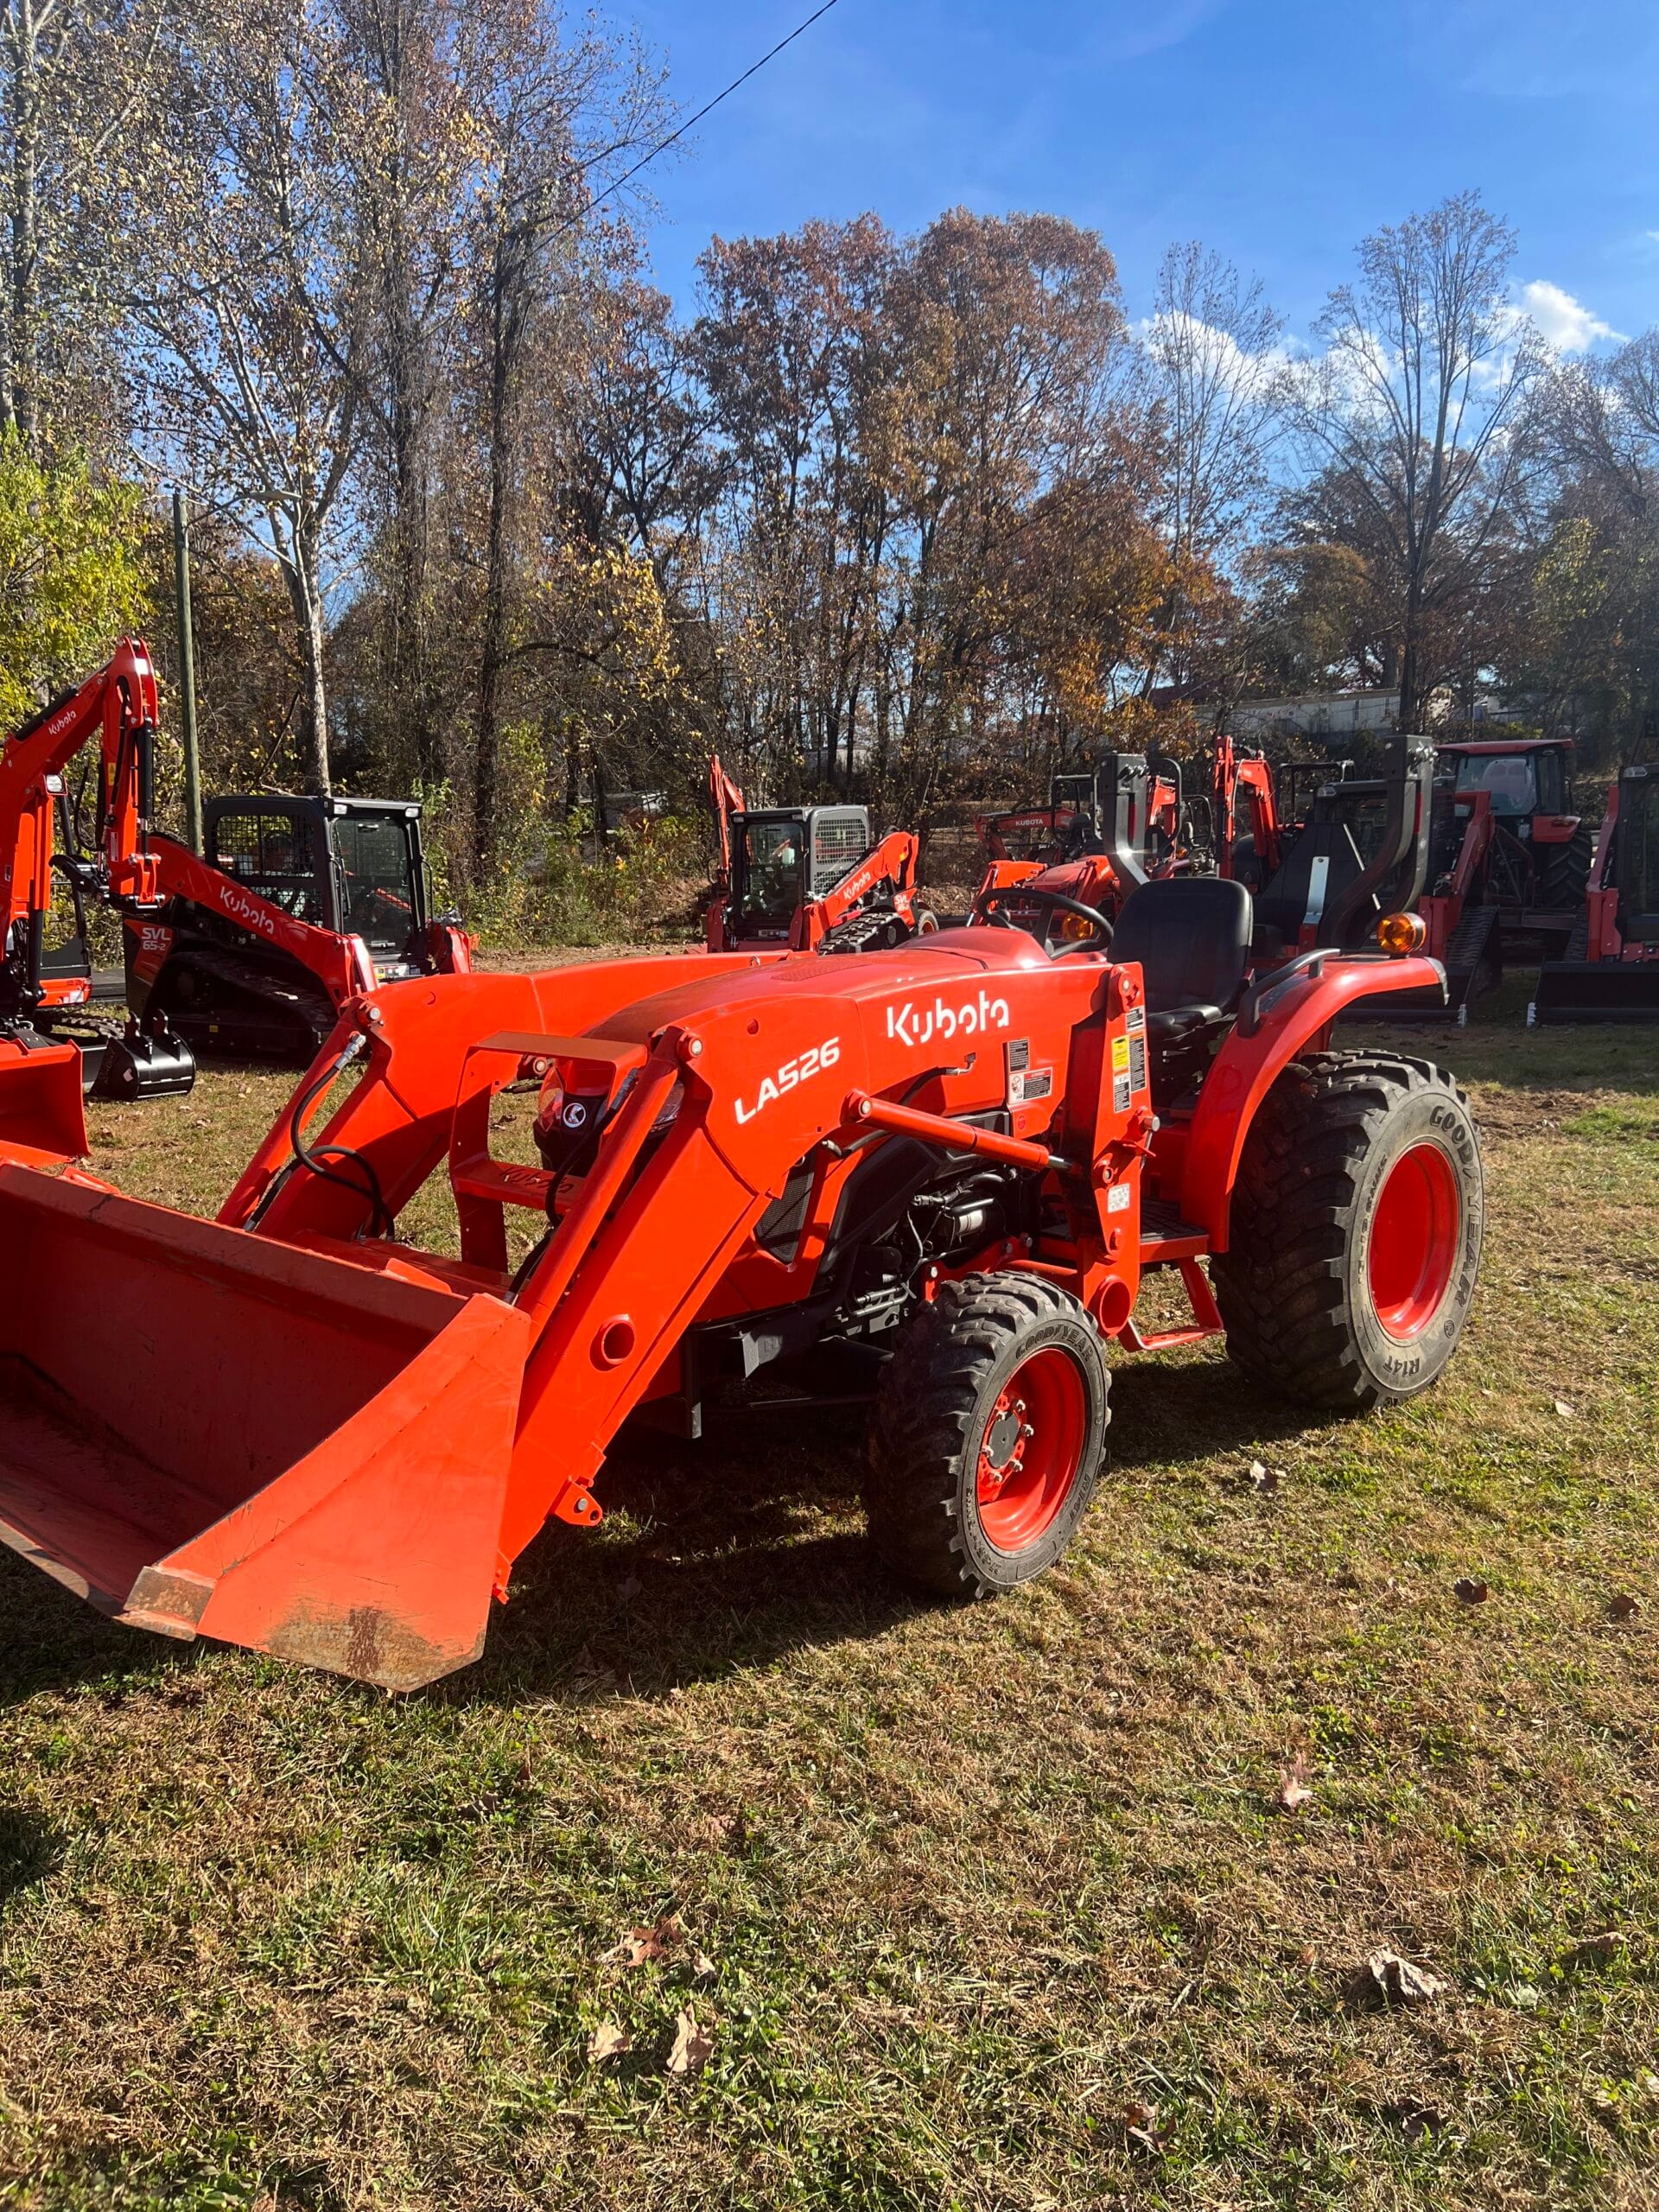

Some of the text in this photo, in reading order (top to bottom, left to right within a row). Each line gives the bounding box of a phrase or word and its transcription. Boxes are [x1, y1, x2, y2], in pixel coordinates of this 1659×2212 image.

[48, 710, 77, 734] Kubota
[1015, 818, 1044, 827] KUBOTA
[843, 872, 871, 899] Kubota
[219, 886, 275, 934] Kubota
[142, 927, 171, 941] SVL
[143, 940, 166, 951] 65-2
[887, 990, 1009, 1046] Kubota
[734, 1037, 840, 1124] LA526
[499, 1166, 575, 1194] Kuboa
[1430, 1105, 1481, 1307] GOODYEAR
[1015, 1324, 1094, 1363] GOODYEAR
[1383, 1354, 1421, 1377] R14T
